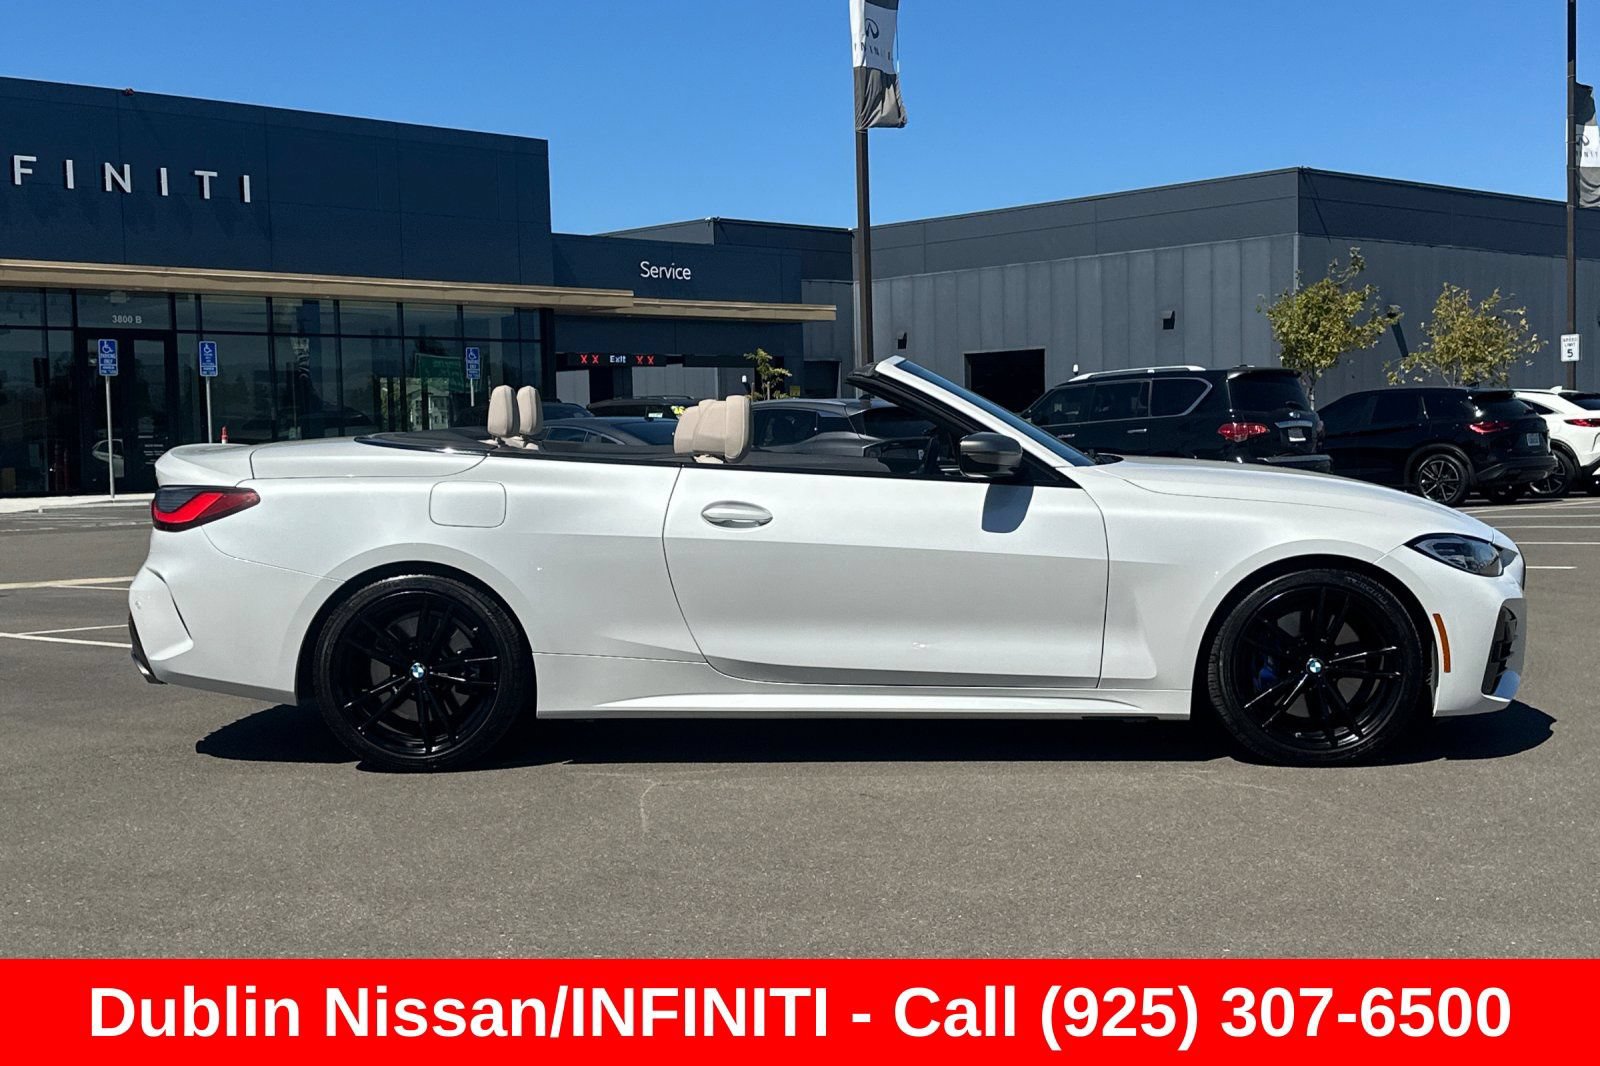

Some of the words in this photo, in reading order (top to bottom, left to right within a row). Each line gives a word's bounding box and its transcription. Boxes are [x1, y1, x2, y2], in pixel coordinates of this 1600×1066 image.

[13, 154, 251, 203] FINITI
[640, 261, 691, 280] Service
[112, 315, 133, 323] 3800
[135, 315, 143, 324] B
[1567, 348, 1574, 358] 5
[609, 354, 627, 364] Exit
